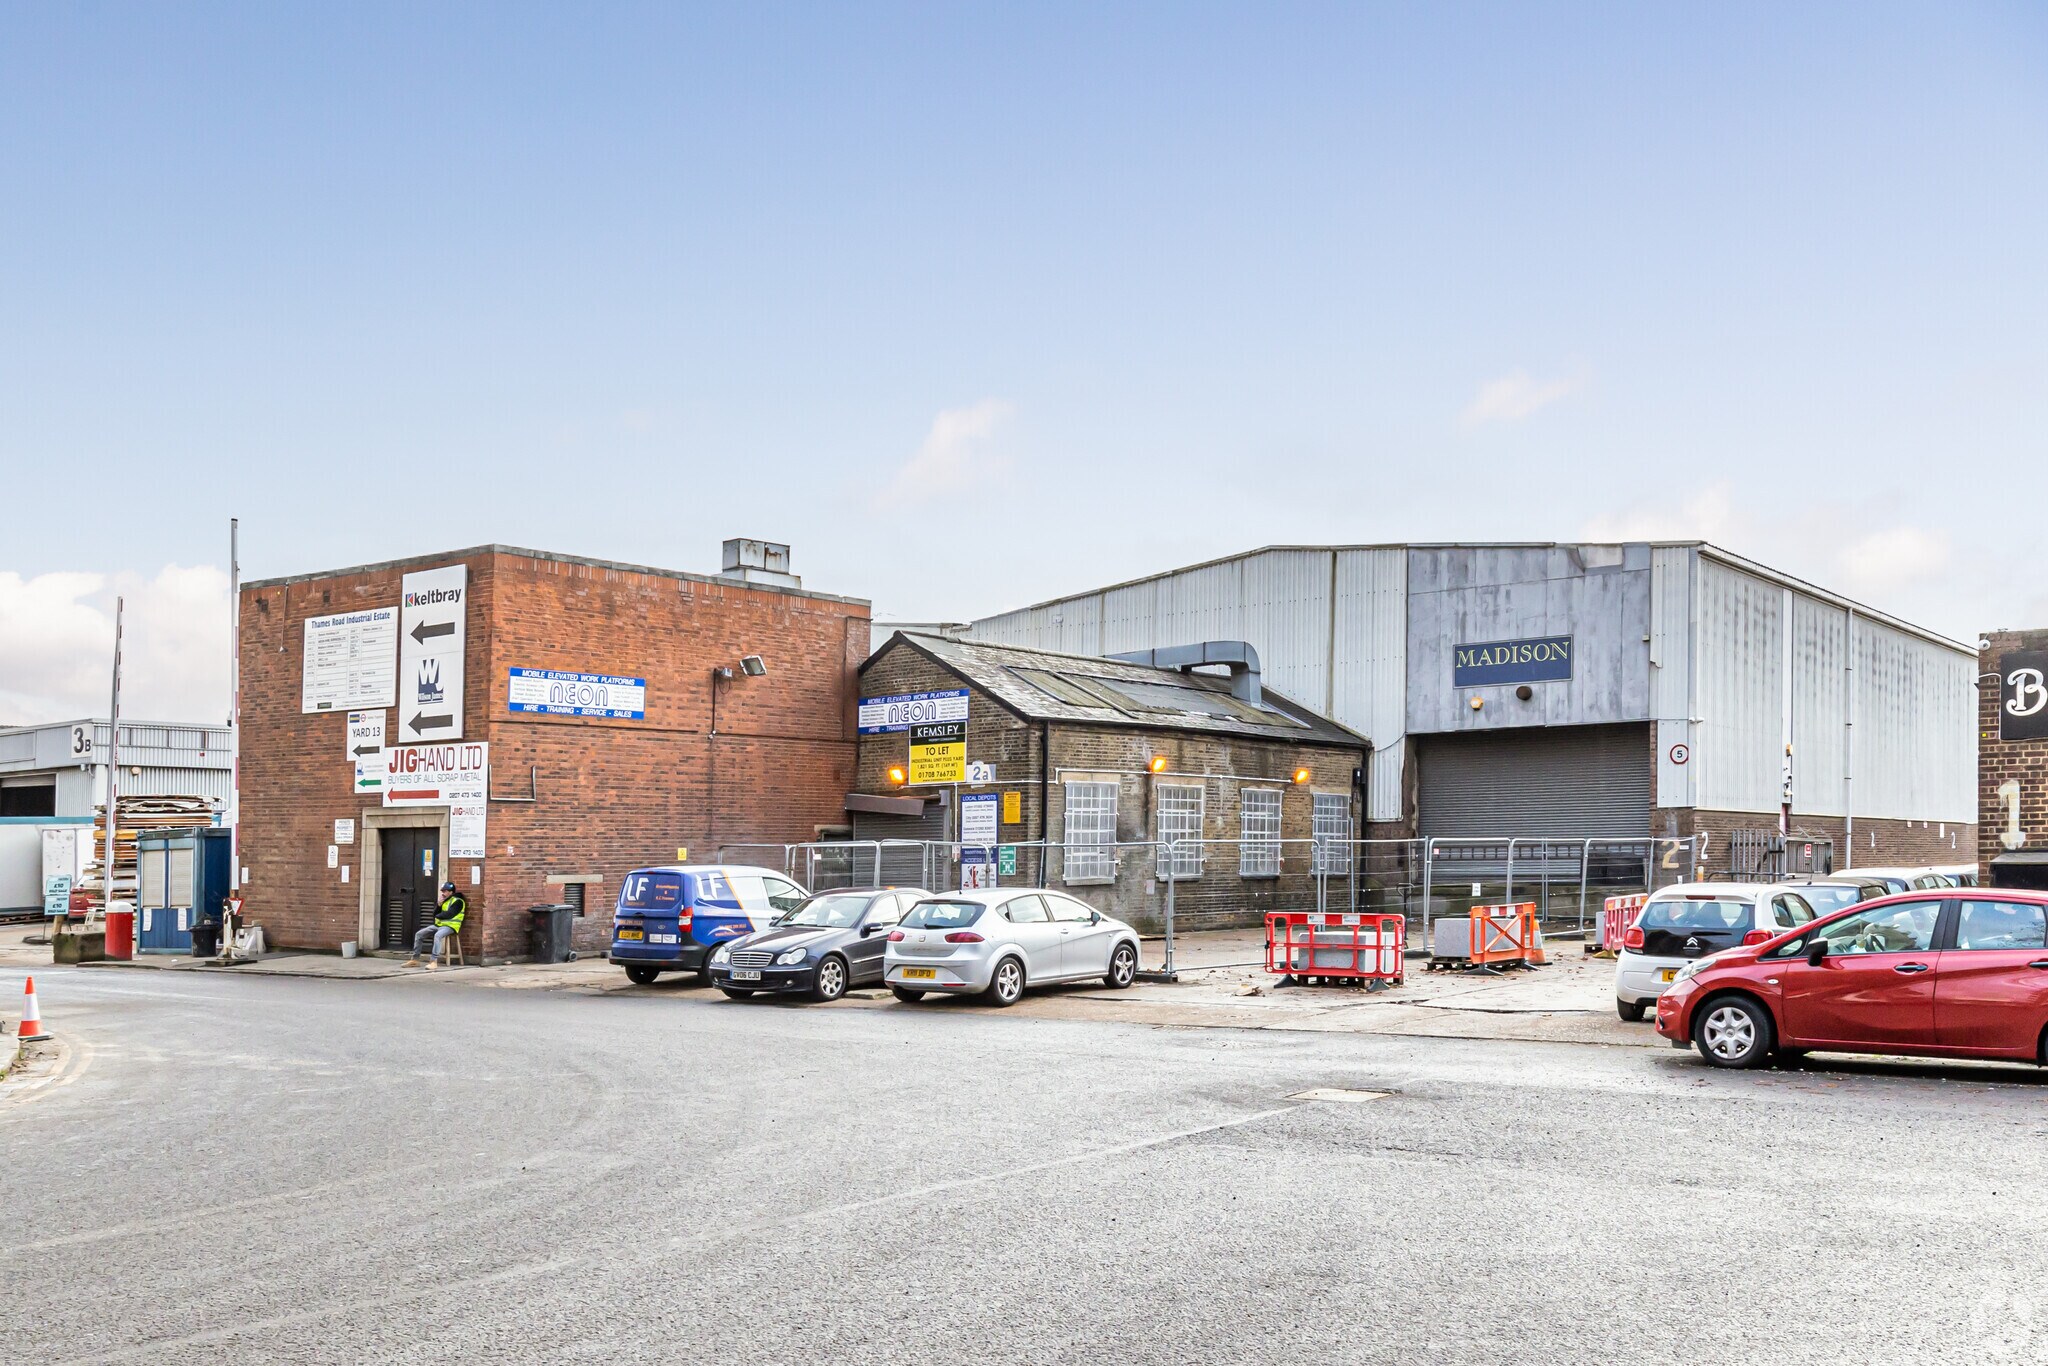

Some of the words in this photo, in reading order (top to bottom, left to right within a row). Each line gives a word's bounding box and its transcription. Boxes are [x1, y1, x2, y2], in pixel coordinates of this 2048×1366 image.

[414, 588, 461, 606] keltbray
[311, 620, 330, 628] Thames
[332, 617, 345, 626] Road
[346, 613, 372, 624] Industrial
[373, 612, 391, 621] Estate
[1456, 641, 1570, 668] MADISON
[522, 669, 545, 679] MOBILE
[547, 672, 579, 681] ELEVATED
[580, 674, 600, 683] WORK
[600, 676, 636, 686] PLATFORMS
[867, 697, 886, 705] MOBILE
[886, 695, 912, 703] ELEVATED
[913, 692, 929, 701] WORK
[930, 690, 960, 699] PLATFORMS
[523, 704, 539, 712] HIRE
[546, 705, 575, 714] TRAINING
[581, 708, 607, 716] SERVICE
[613, 710, 633, 718] SALES
[352, 727, 371, 738] YARD
[372, 726, 381, 737] 13
[886, 724, 909, 732] TRAINING
[917, 724, 959, 738] KEMSLEY
[926, 747, 936, 756] TO
[938, 746, 949, 755] LET
[1677, 750, 1683, 759] 5
[389, 746, 455, 773] JIGHAND
[460, 745, 482, 771] LTD
[388, 775, 412, 785] BUYERS
[413, 775, 422, 784] OF
[423, 773, 435, 783] ALL
[436, 772, 459, 783] SCRAP
[460, 772, 482, 781] METAL
[918, 771, 935, 779] 01708
[452, 807, 476, 816] JIGHAND
[476, 806, 485, 816] LTD
[1998, 779, 2026, 850] 1
[1700, 831, 1709, 860] 2
[1661, 838, 1680, 869] 2
